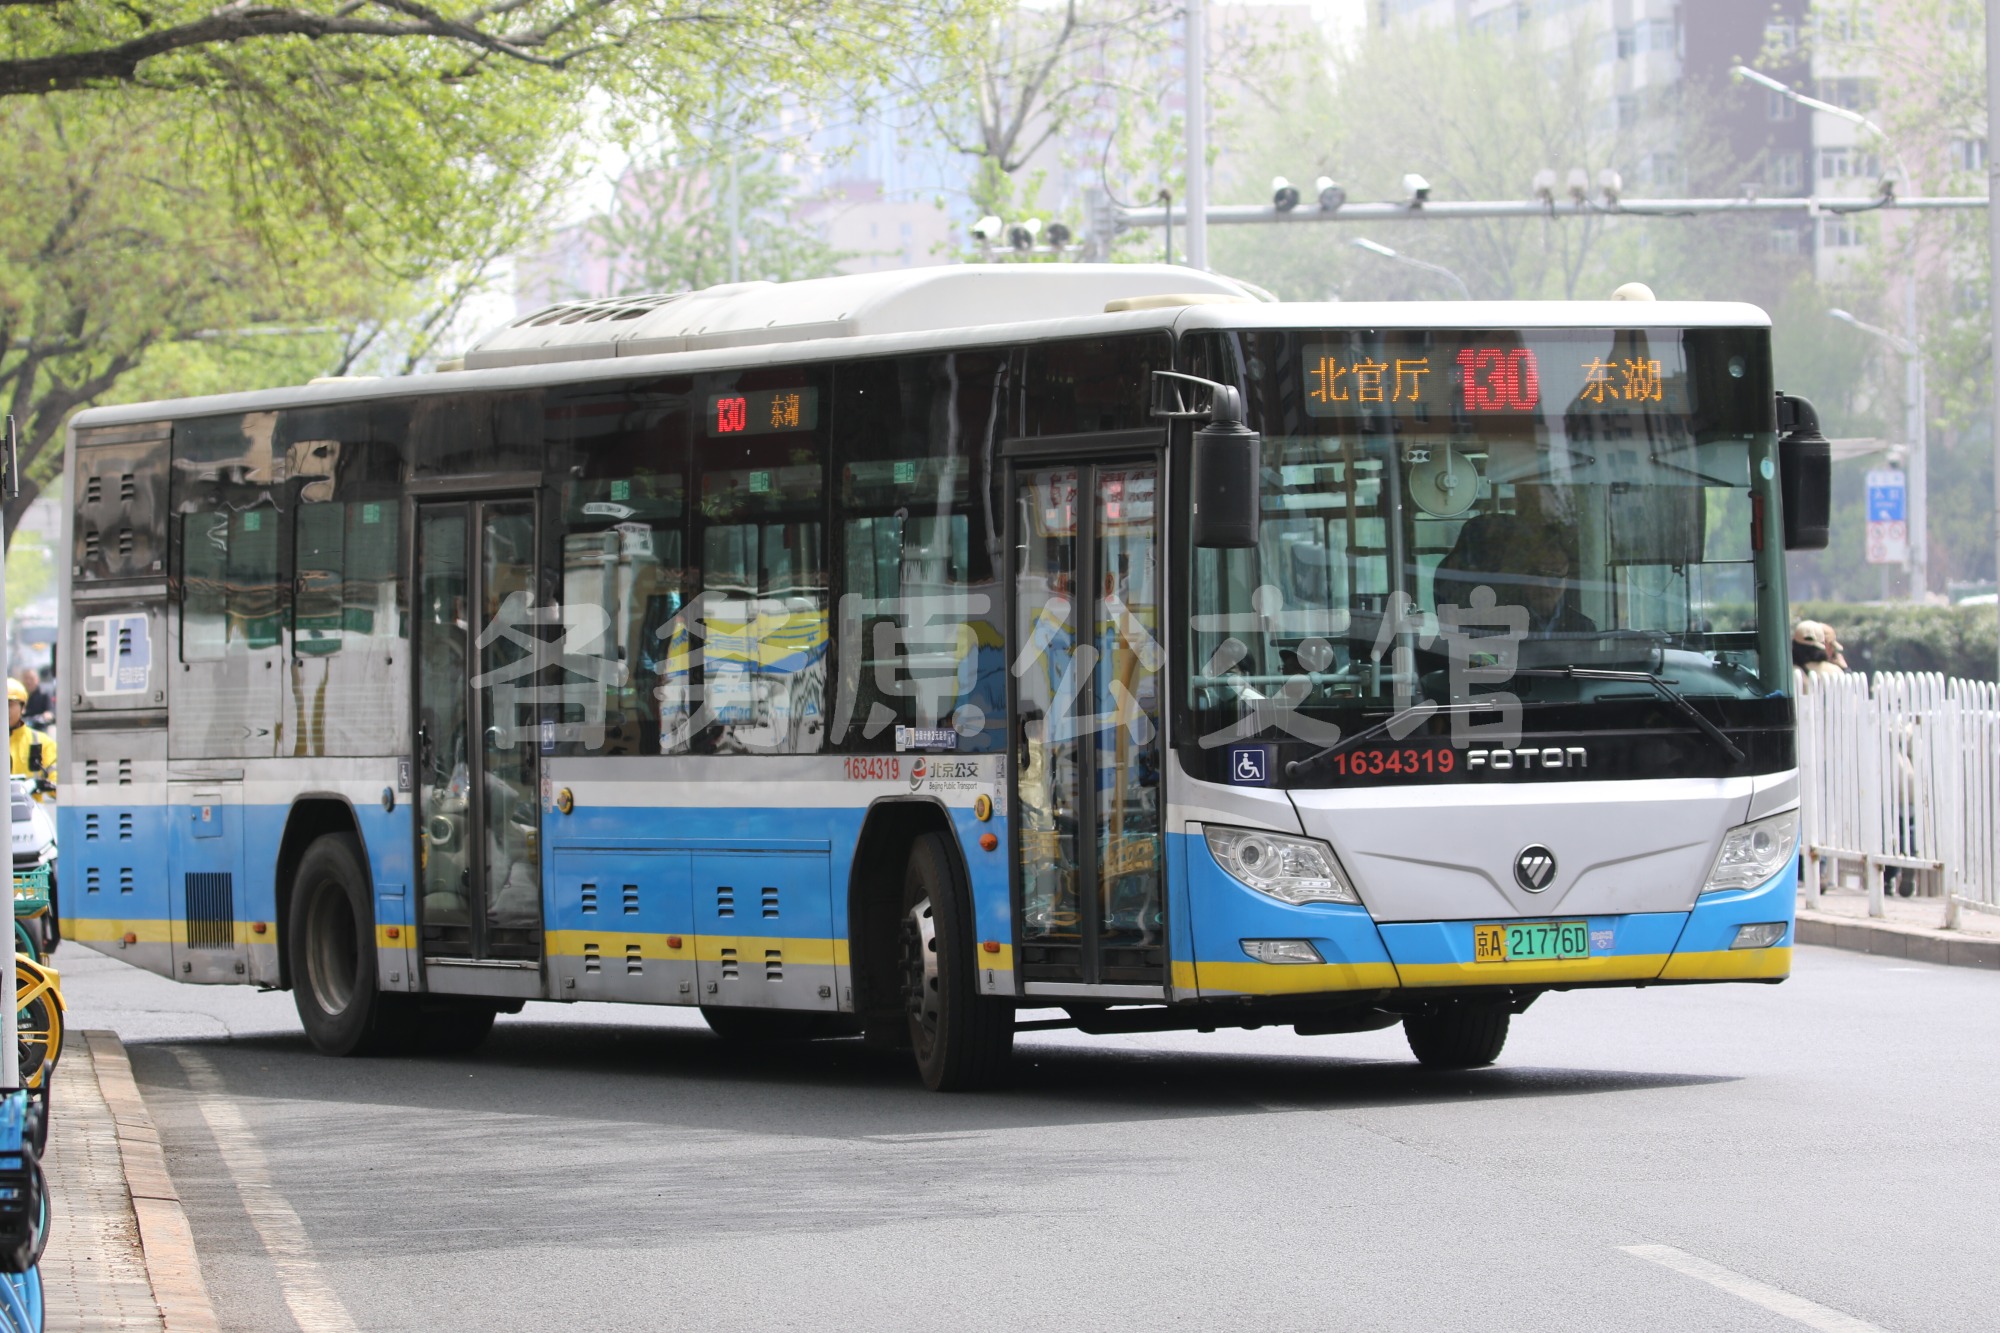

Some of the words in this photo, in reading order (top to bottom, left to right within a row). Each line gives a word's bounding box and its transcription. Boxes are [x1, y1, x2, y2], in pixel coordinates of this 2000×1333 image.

[1310, 357, 1430, 402] 北官厅
[1457, 348, 1539, 410] 130
[1580, 356, 1662, 403] 东湖
[717, 397, 746, 432] 130
[770, 394, 799, 428] 东湖
[844, 757, 899, 780] 1634319
[929, 762, 979, 778] 北京公交
[1334, 749, 1454, 775] 1634319
[1466, 747, 1588, 770] FOTON
[929, 781, 943, 791] Beijing
[944, 781, 957, 789] Public
[957, 781, 978, 791] Transport
[1477, 931, 1502, 957] 京A
[1511, 927, 1587, 955] 21776D
